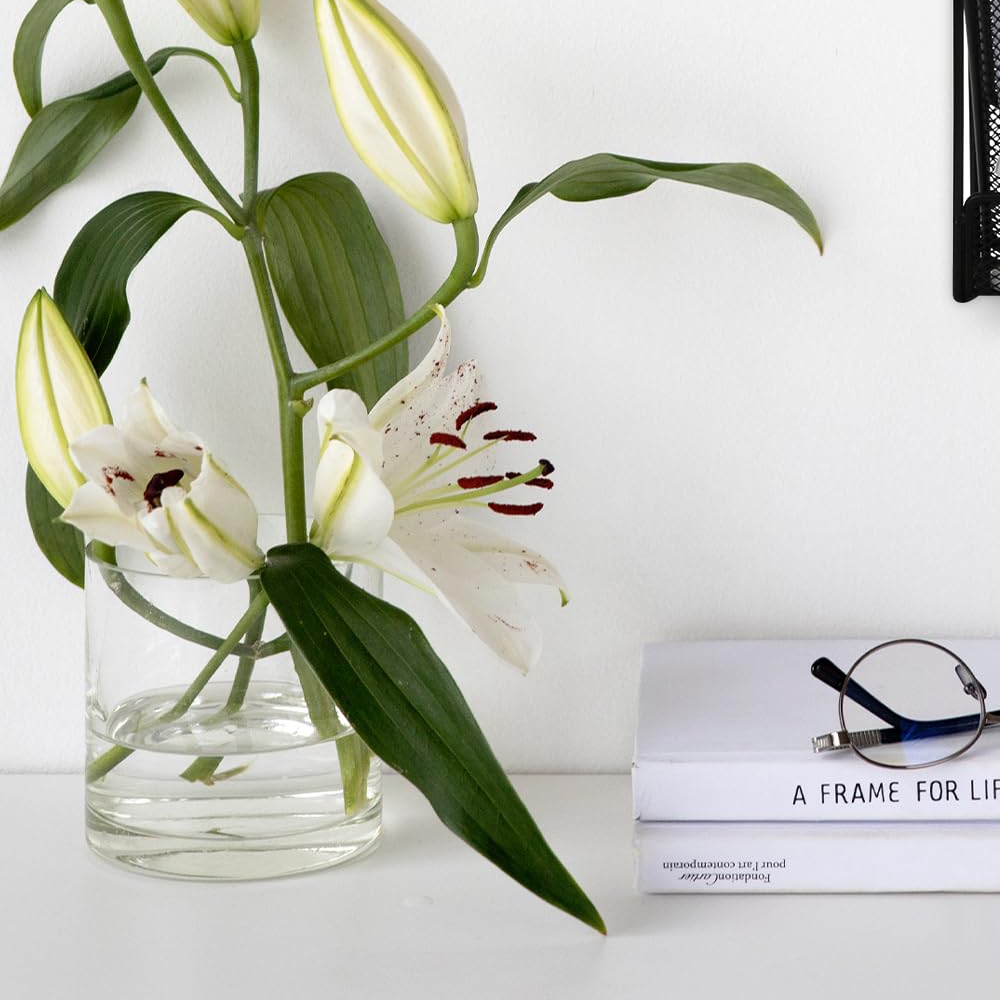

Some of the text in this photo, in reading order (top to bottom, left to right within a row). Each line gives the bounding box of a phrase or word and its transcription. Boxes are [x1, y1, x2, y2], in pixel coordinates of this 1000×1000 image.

[792, 784, 807, 806] A
[820, 781, 900, 805] FRAME
[916, 779, 960, 803] FOR
[662, 859, 787, 872] pour l'art contemporain
